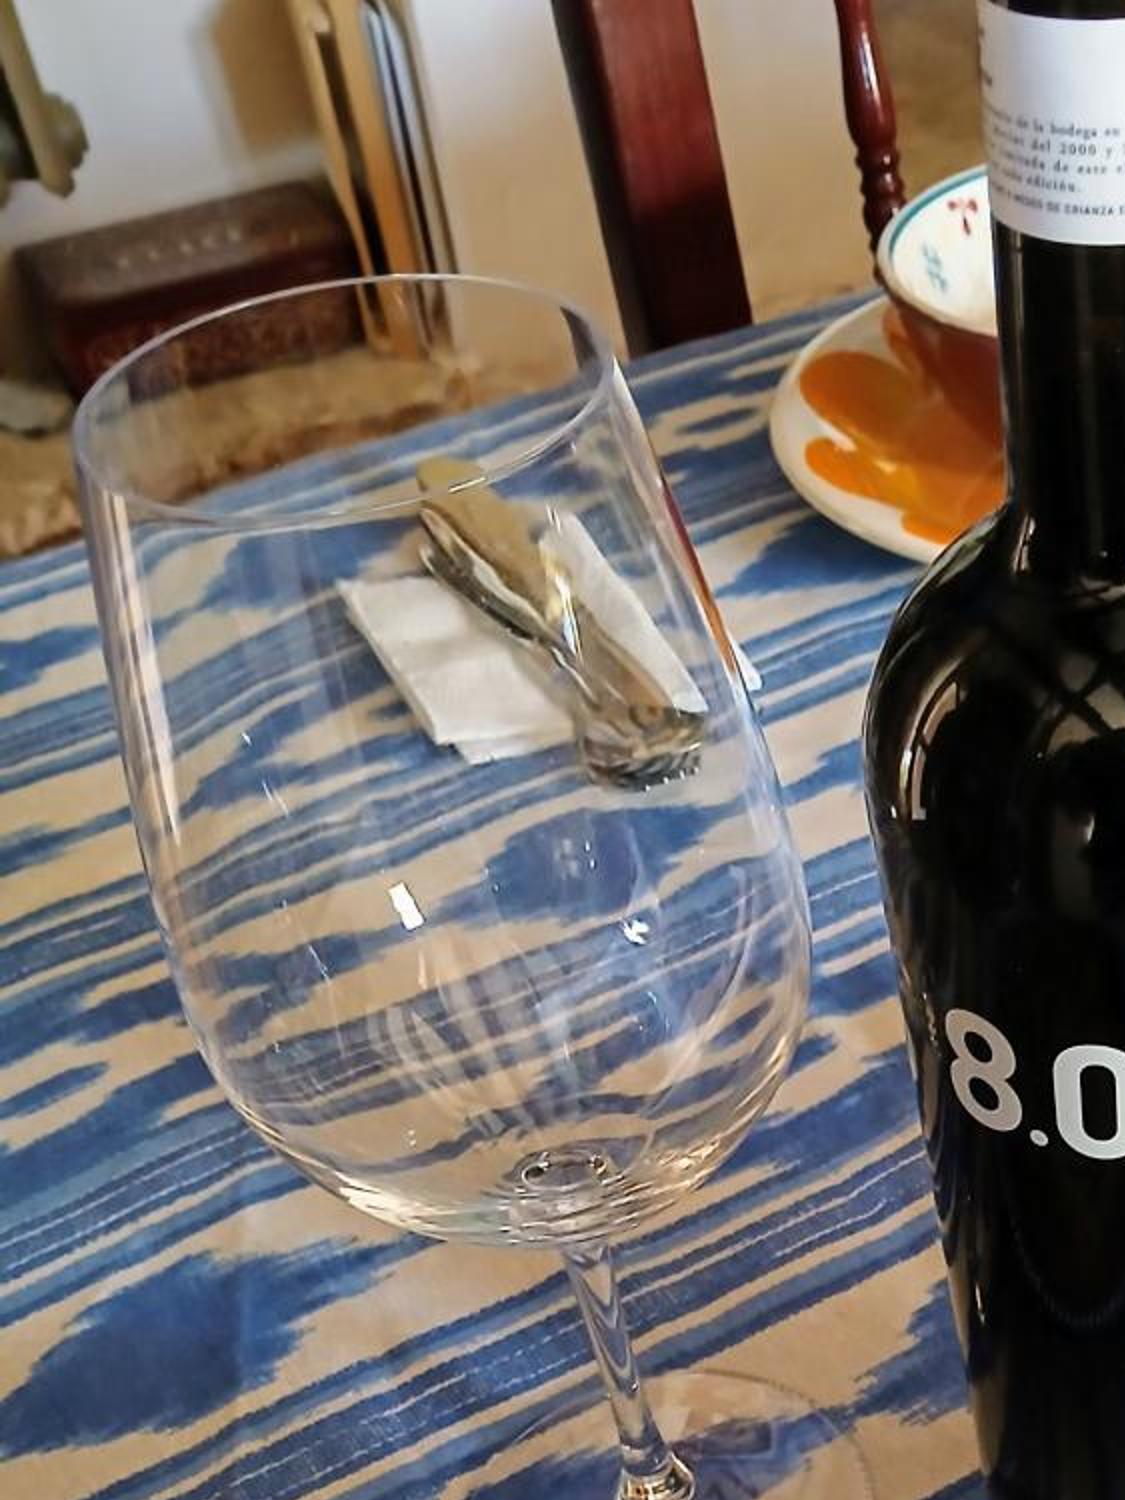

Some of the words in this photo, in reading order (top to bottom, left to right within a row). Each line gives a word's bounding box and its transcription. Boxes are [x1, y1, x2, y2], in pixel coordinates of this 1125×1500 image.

[1050, 122, 1098, 140] bodega
[1060, 143, 1097, 156] 2000
[1053, 159, 1069, 173] de
[1064, 202, 1115, 217] CRIANZA
